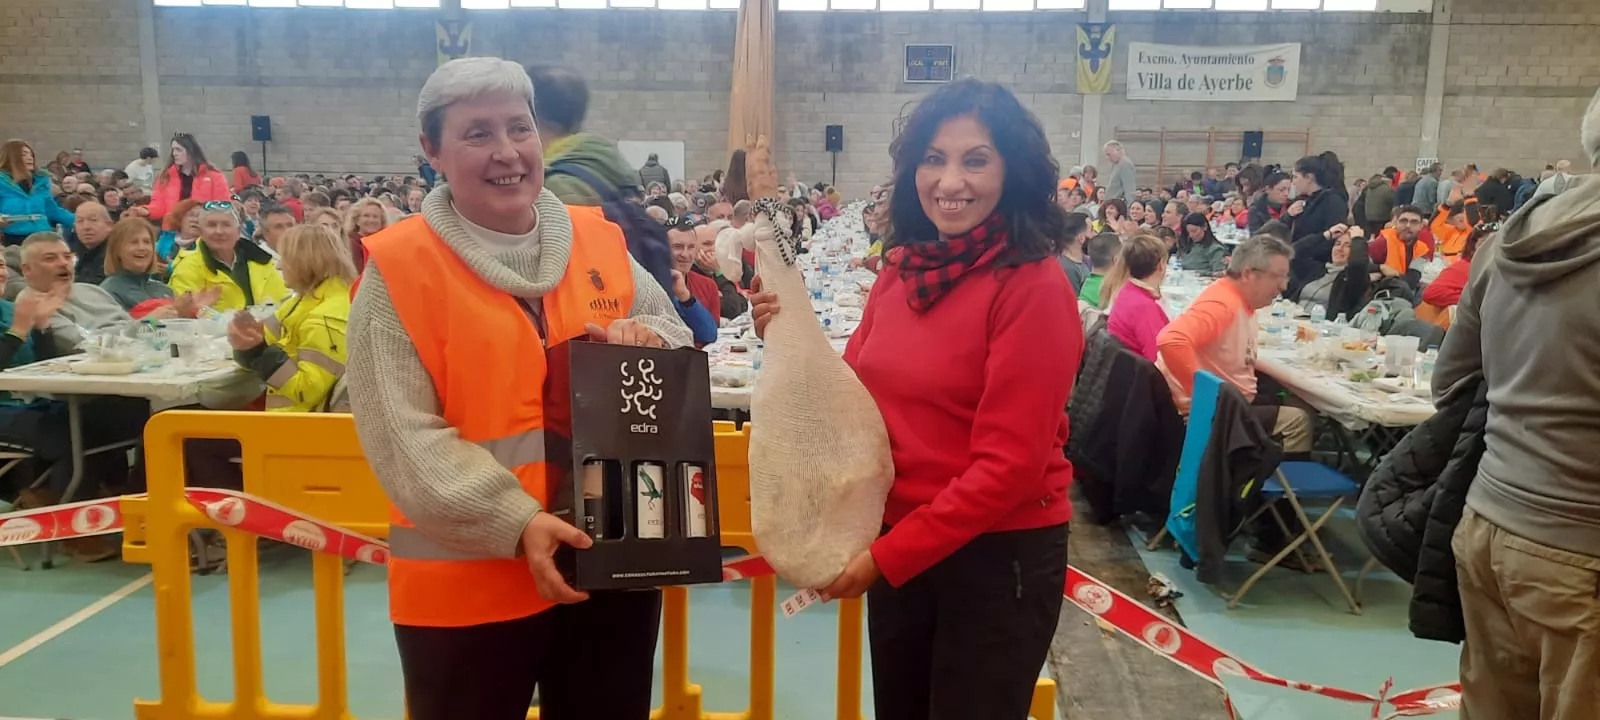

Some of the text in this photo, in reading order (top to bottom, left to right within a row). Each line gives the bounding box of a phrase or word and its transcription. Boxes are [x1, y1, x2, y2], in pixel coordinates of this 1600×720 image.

[1138, 51, 1255, 68] Excmo. Ayuntamiento
[1137, 72, 1253, 95] Villa de Ayerbe
[631, 422, 658, 434] edra
